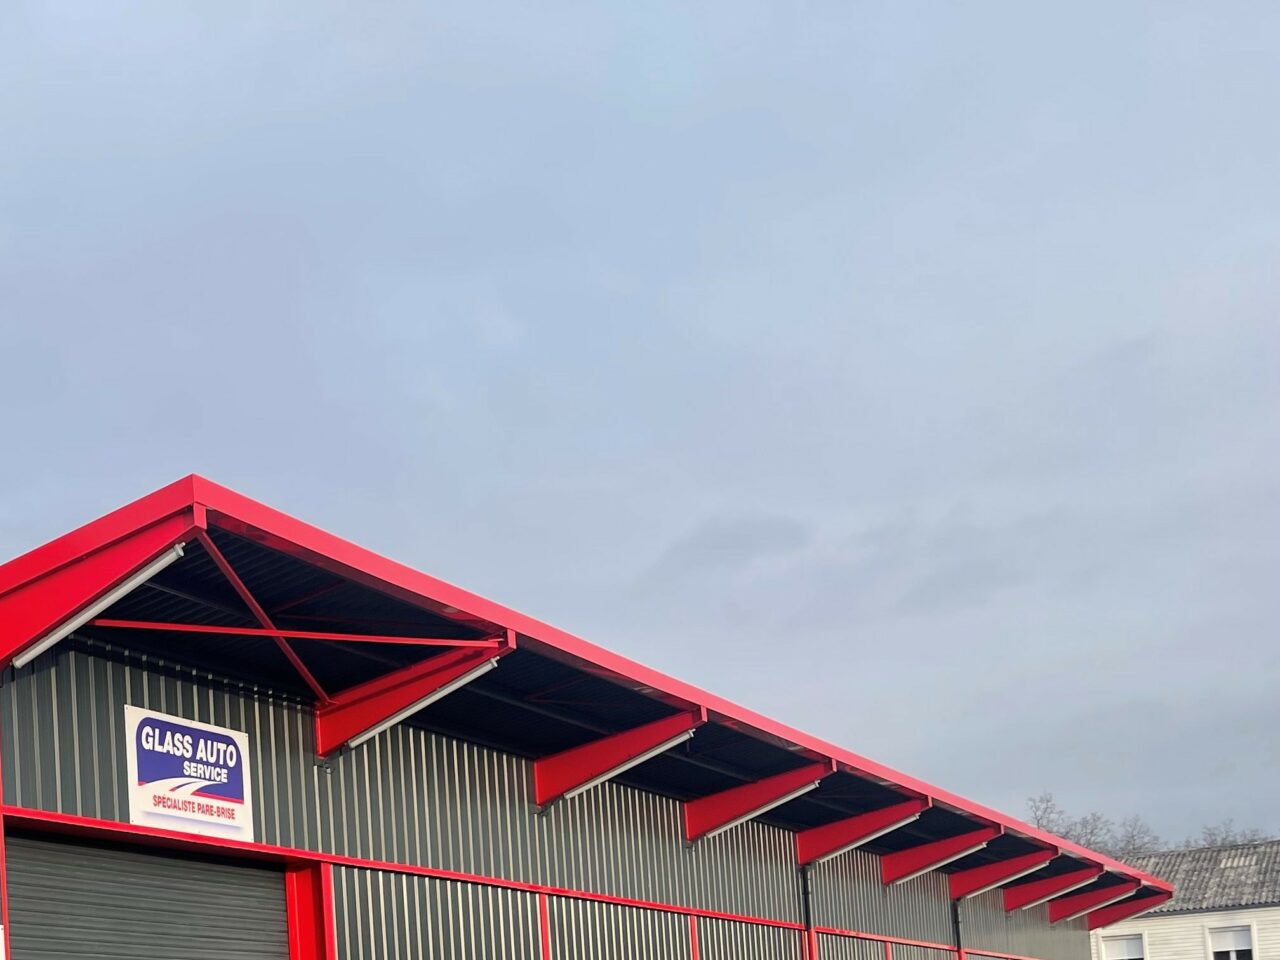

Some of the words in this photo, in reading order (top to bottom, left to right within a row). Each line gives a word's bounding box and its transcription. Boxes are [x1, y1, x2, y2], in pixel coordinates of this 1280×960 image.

[141, 726, 193, 758] GLASS
[196, 739, 237, 767] AUTO
[183, 761, 228, 783] SERVICE
[153, 794, 196, 813] SPÉCIALISTE
[197, 802, 236, 820] PARE-BRISE
